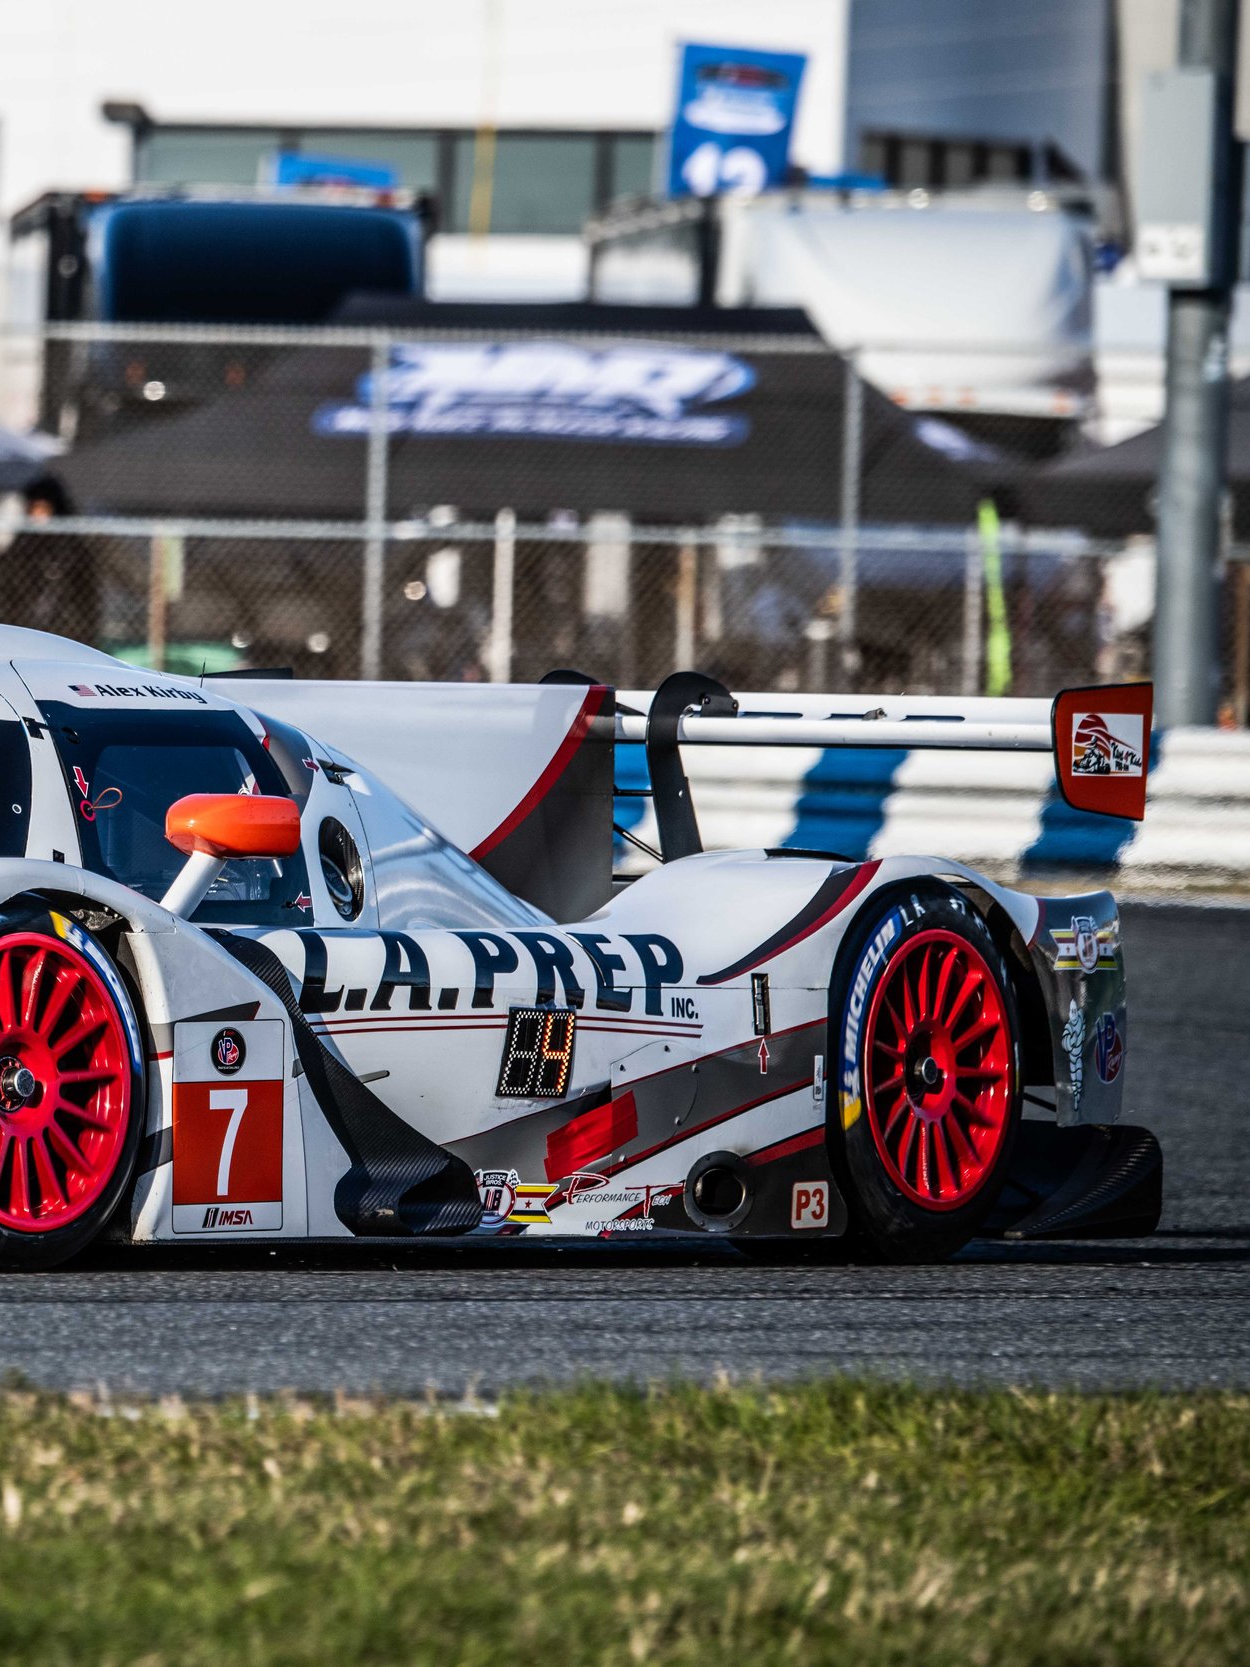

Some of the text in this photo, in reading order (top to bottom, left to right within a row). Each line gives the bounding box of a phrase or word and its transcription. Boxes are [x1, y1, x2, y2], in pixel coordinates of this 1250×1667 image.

[94, 684, 207, 704] Alex Kirby
[845, 917, 896, 1064] MICHELIN
[671, 997, 699, 1019] INC.
[209, 1088, 249, 1197] 7
[795, 1187, 825, 1221] P3
[218, 1209, 254, 1226] IMSA
[585, 1218, 655, 1232] MOTORSPORTS
